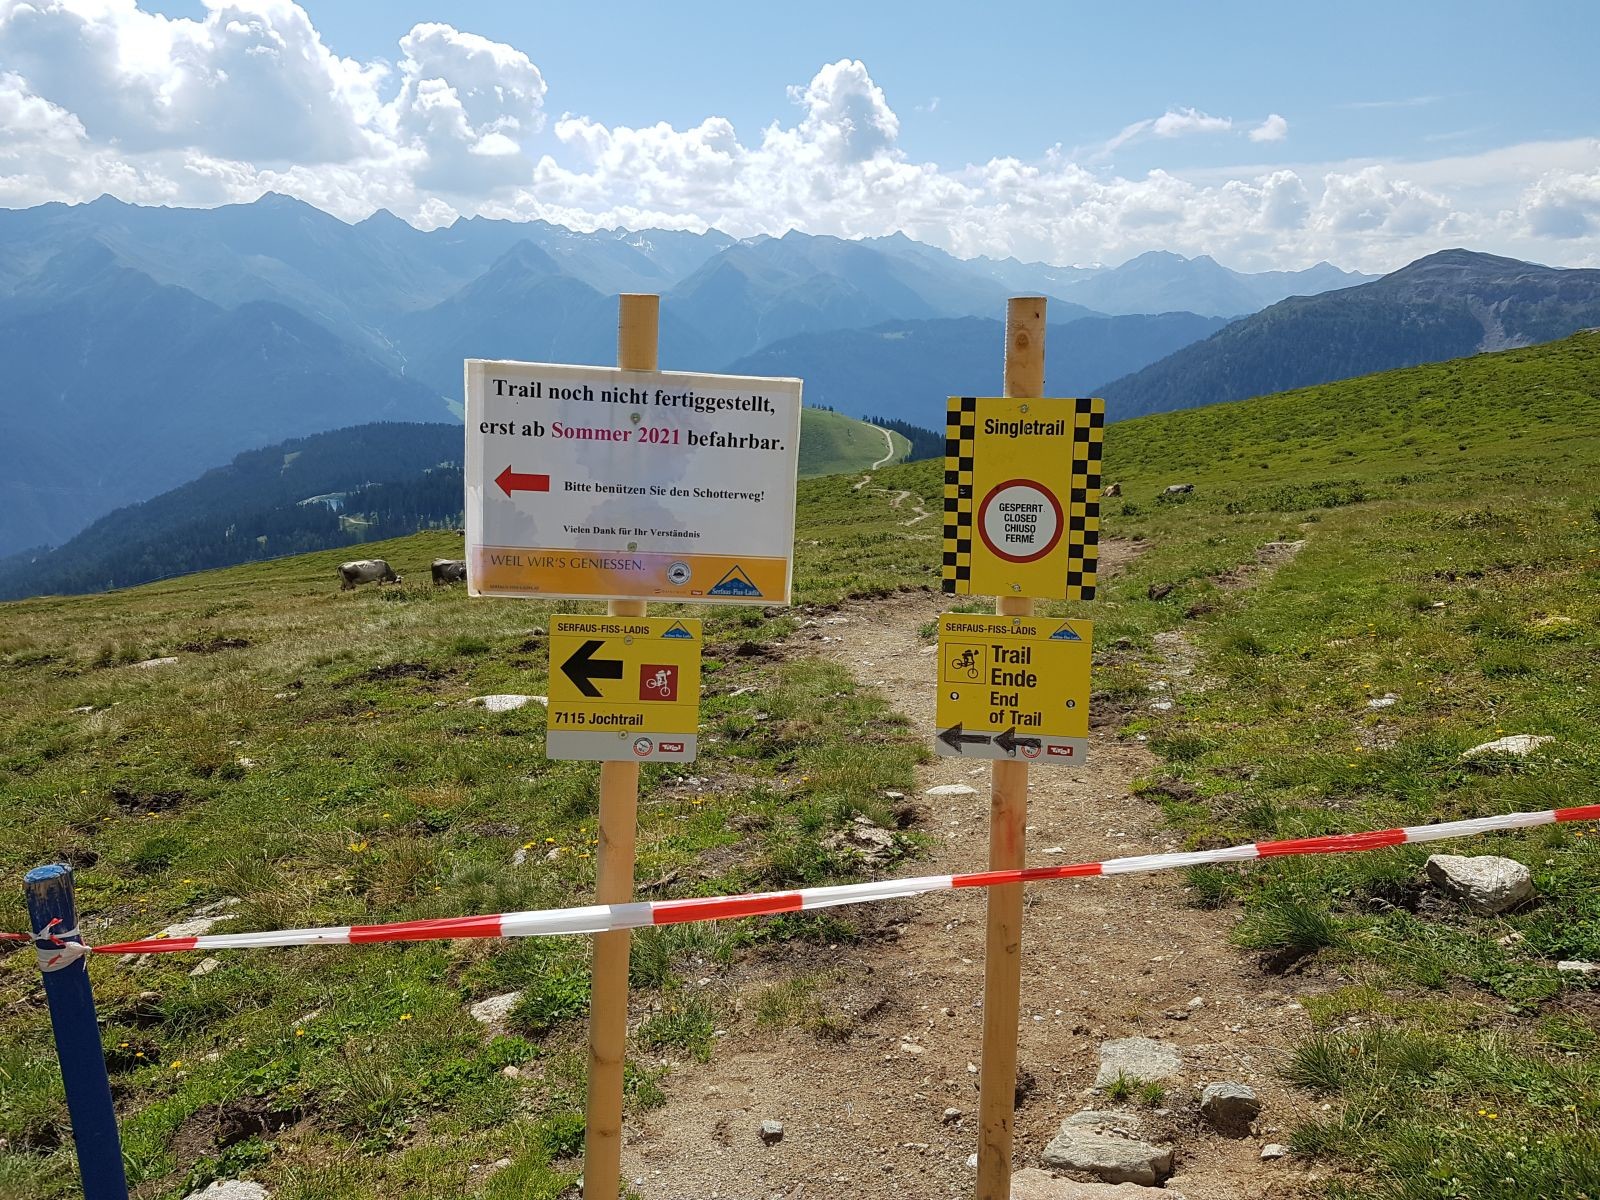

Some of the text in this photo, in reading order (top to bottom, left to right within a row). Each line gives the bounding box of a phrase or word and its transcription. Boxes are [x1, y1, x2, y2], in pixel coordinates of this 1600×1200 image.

[492, 378, 776, 416] Trail noch nicht fertiggestellt,
[479, 421, 785, 451] erst ab Sommer 2021 befahrbar.
[984, 419, 1065, 438] Singletrail
[564, 480, 765, 502] Bitte benützen Sie den Schotterweg!
[999, 502, 1044, 513] GESPERRT
[1004, 513, 1037, 523] CLOSED
[562, 525, 701, 539] Vielen Dank für Ihr Verständnis
[1004, 523, 1036, 533] CHIUSO
[490, 555, 524, 567] WEIL
[570, 557, 646, 571] GENIESSEN.
[557, 622, 650, 635] SERFAUS-FISS-LADIS
[945, 622, 1037, 635] SERFAUS-FISS-LADIS
[991, 644, 1031, 665] Trail
[991, 668, 1037, 688] Ende
[990, 691, 1019, 707] End
[555, 712, 644, 726] 7115 Jochtrail
[989, 709, 1042, 726] of Trail
